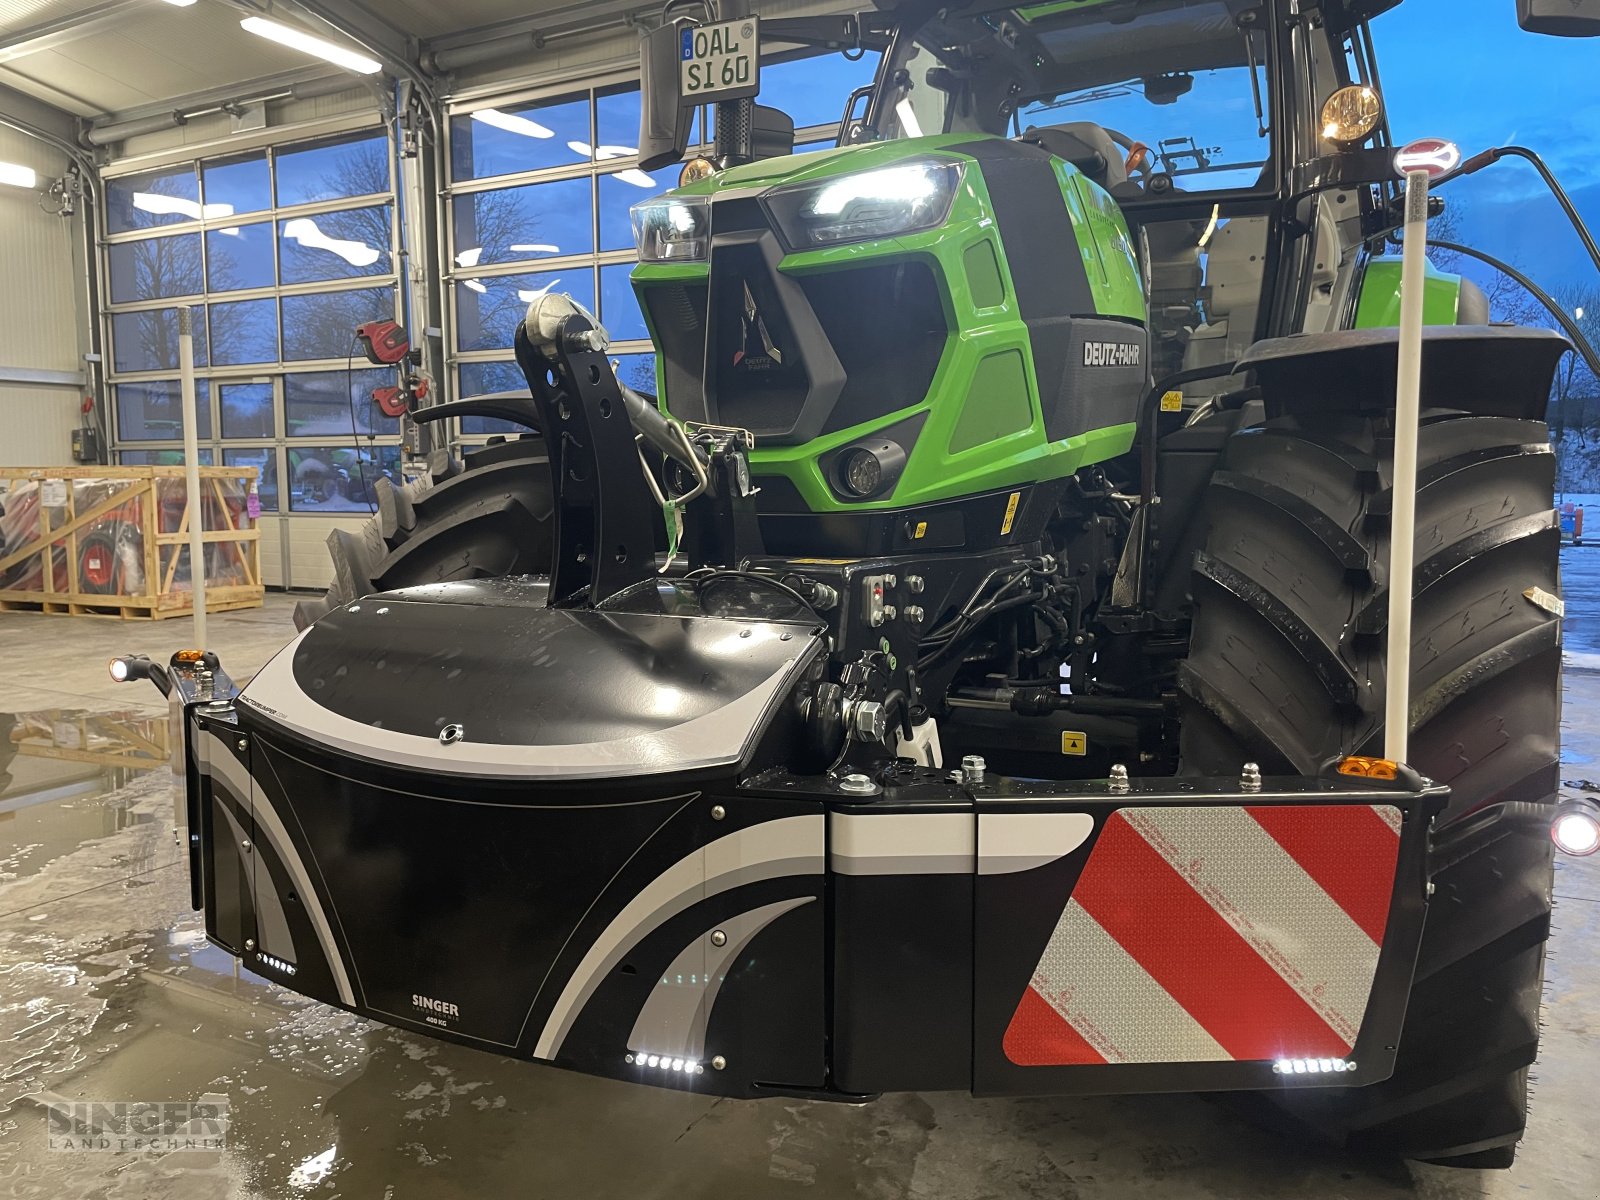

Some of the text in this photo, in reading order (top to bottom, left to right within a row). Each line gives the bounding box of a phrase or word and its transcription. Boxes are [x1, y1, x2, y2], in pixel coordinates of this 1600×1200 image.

[685, 49, 690, 57] D
[695, 27, 739, 59] OAL
[688, 55, 749, 91] SI 60
[1084, 342, 1140, 366] DEUTZ-FAHR
[412, 994, 459, 1017] SINGER
[438, 1019, 447, 1027] KG
